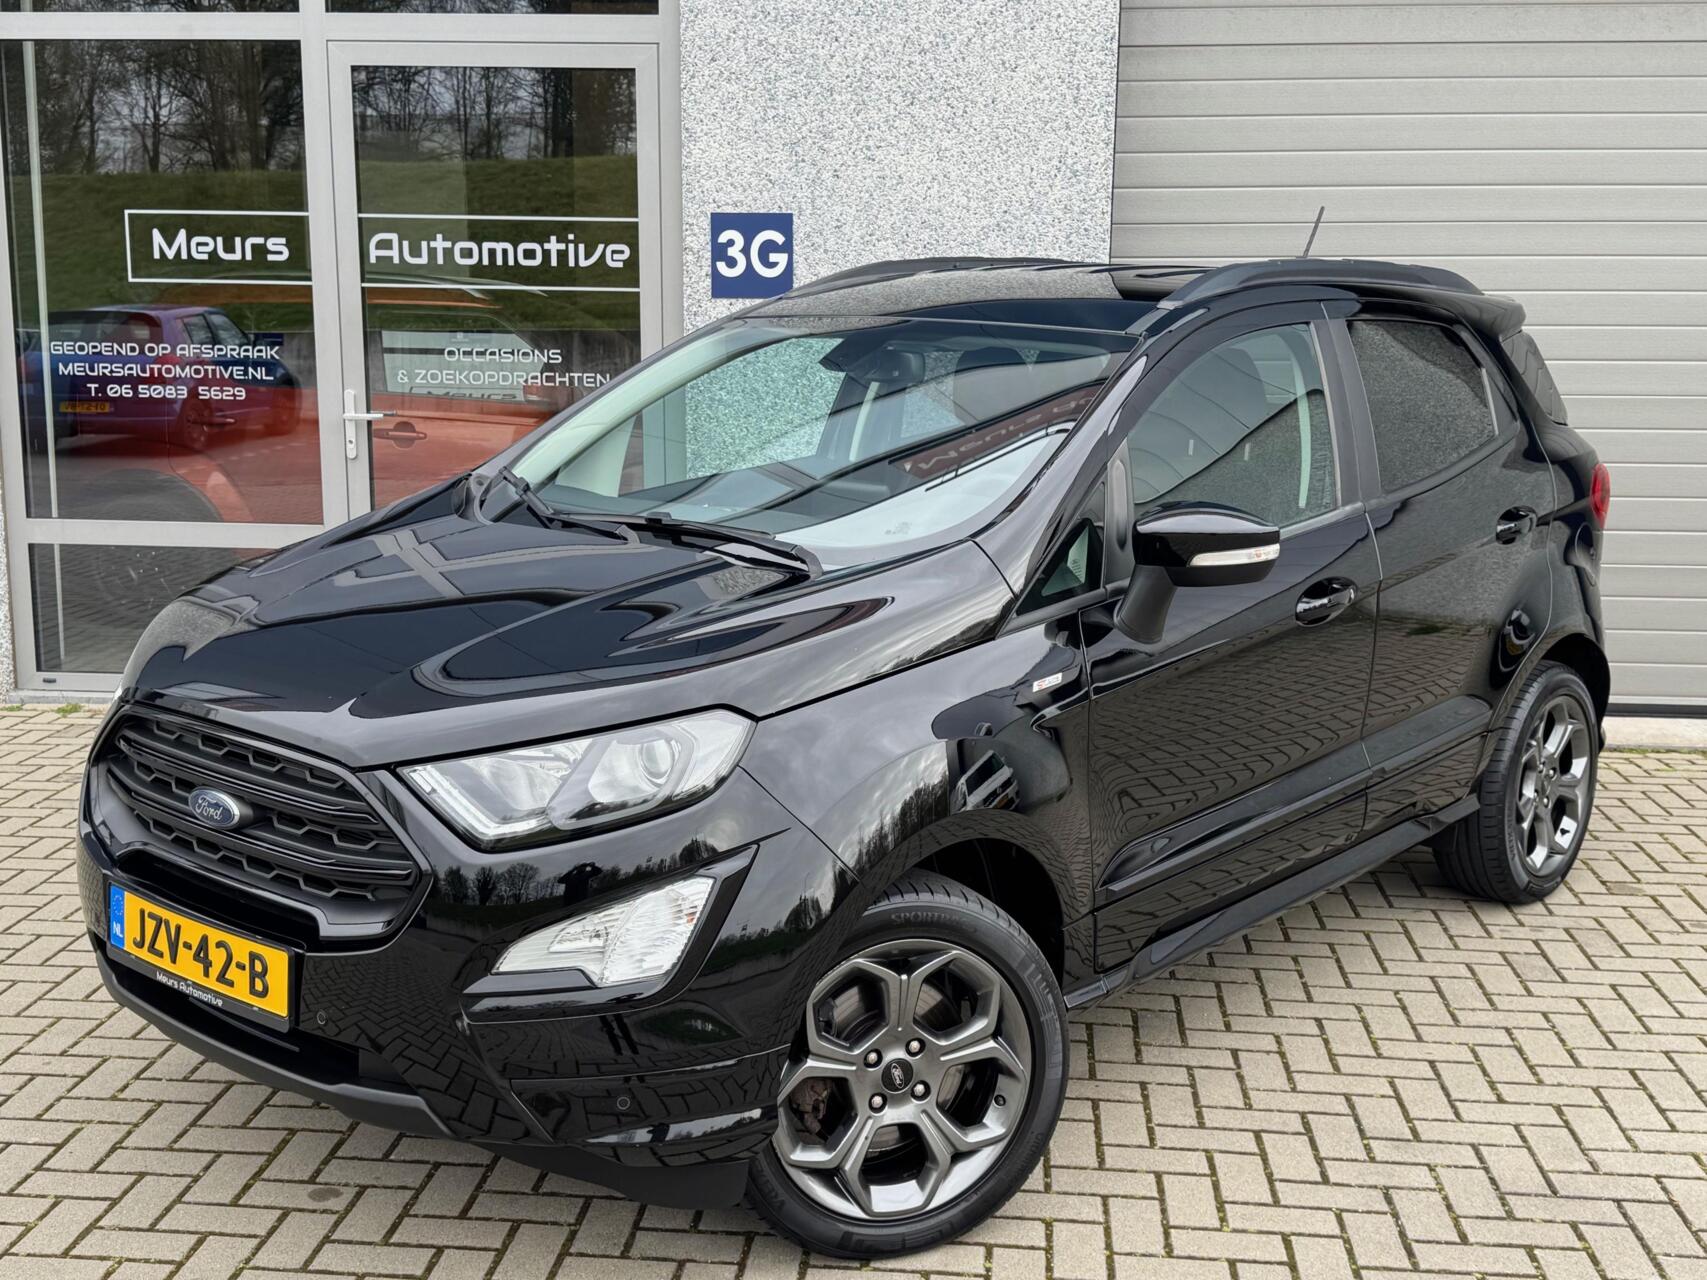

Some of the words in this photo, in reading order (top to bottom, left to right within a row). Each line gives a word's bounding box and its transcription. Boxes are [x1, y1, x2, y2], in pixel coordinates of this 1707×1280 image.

[152, 228, 290, 262] Meurs
[369, 232, 631, 268] Automotive
[716, 229, 789, 278] 3G
[50, 341, 140, 356] GEOPEND
[144, 343, 172, 357] OP
[176, 344, 280, 360] AFSPRAAK
[444, 347, 563, 363] OCCASIONS
[58, 363, 275, 380] MEURSAUTOMOTIVE.NL
[397, 369, 409, 383] &
[414, 369, 610, 387] ZOEKOPDRACHTEN
[86, 384, 102, 398] T.
[106, 385, 133, 398] 06
[138, 385, 188, 399] 5083
[198, 386, 246, 400] 5629
[195, 794, 223, 820] Ford
[112, 921, 124, 938] NL
[132, 907, 270, 1000] JZV-42-B
[156, 970, 179, 989] Meurs
[179, 982, 223, 1007] Automotive
